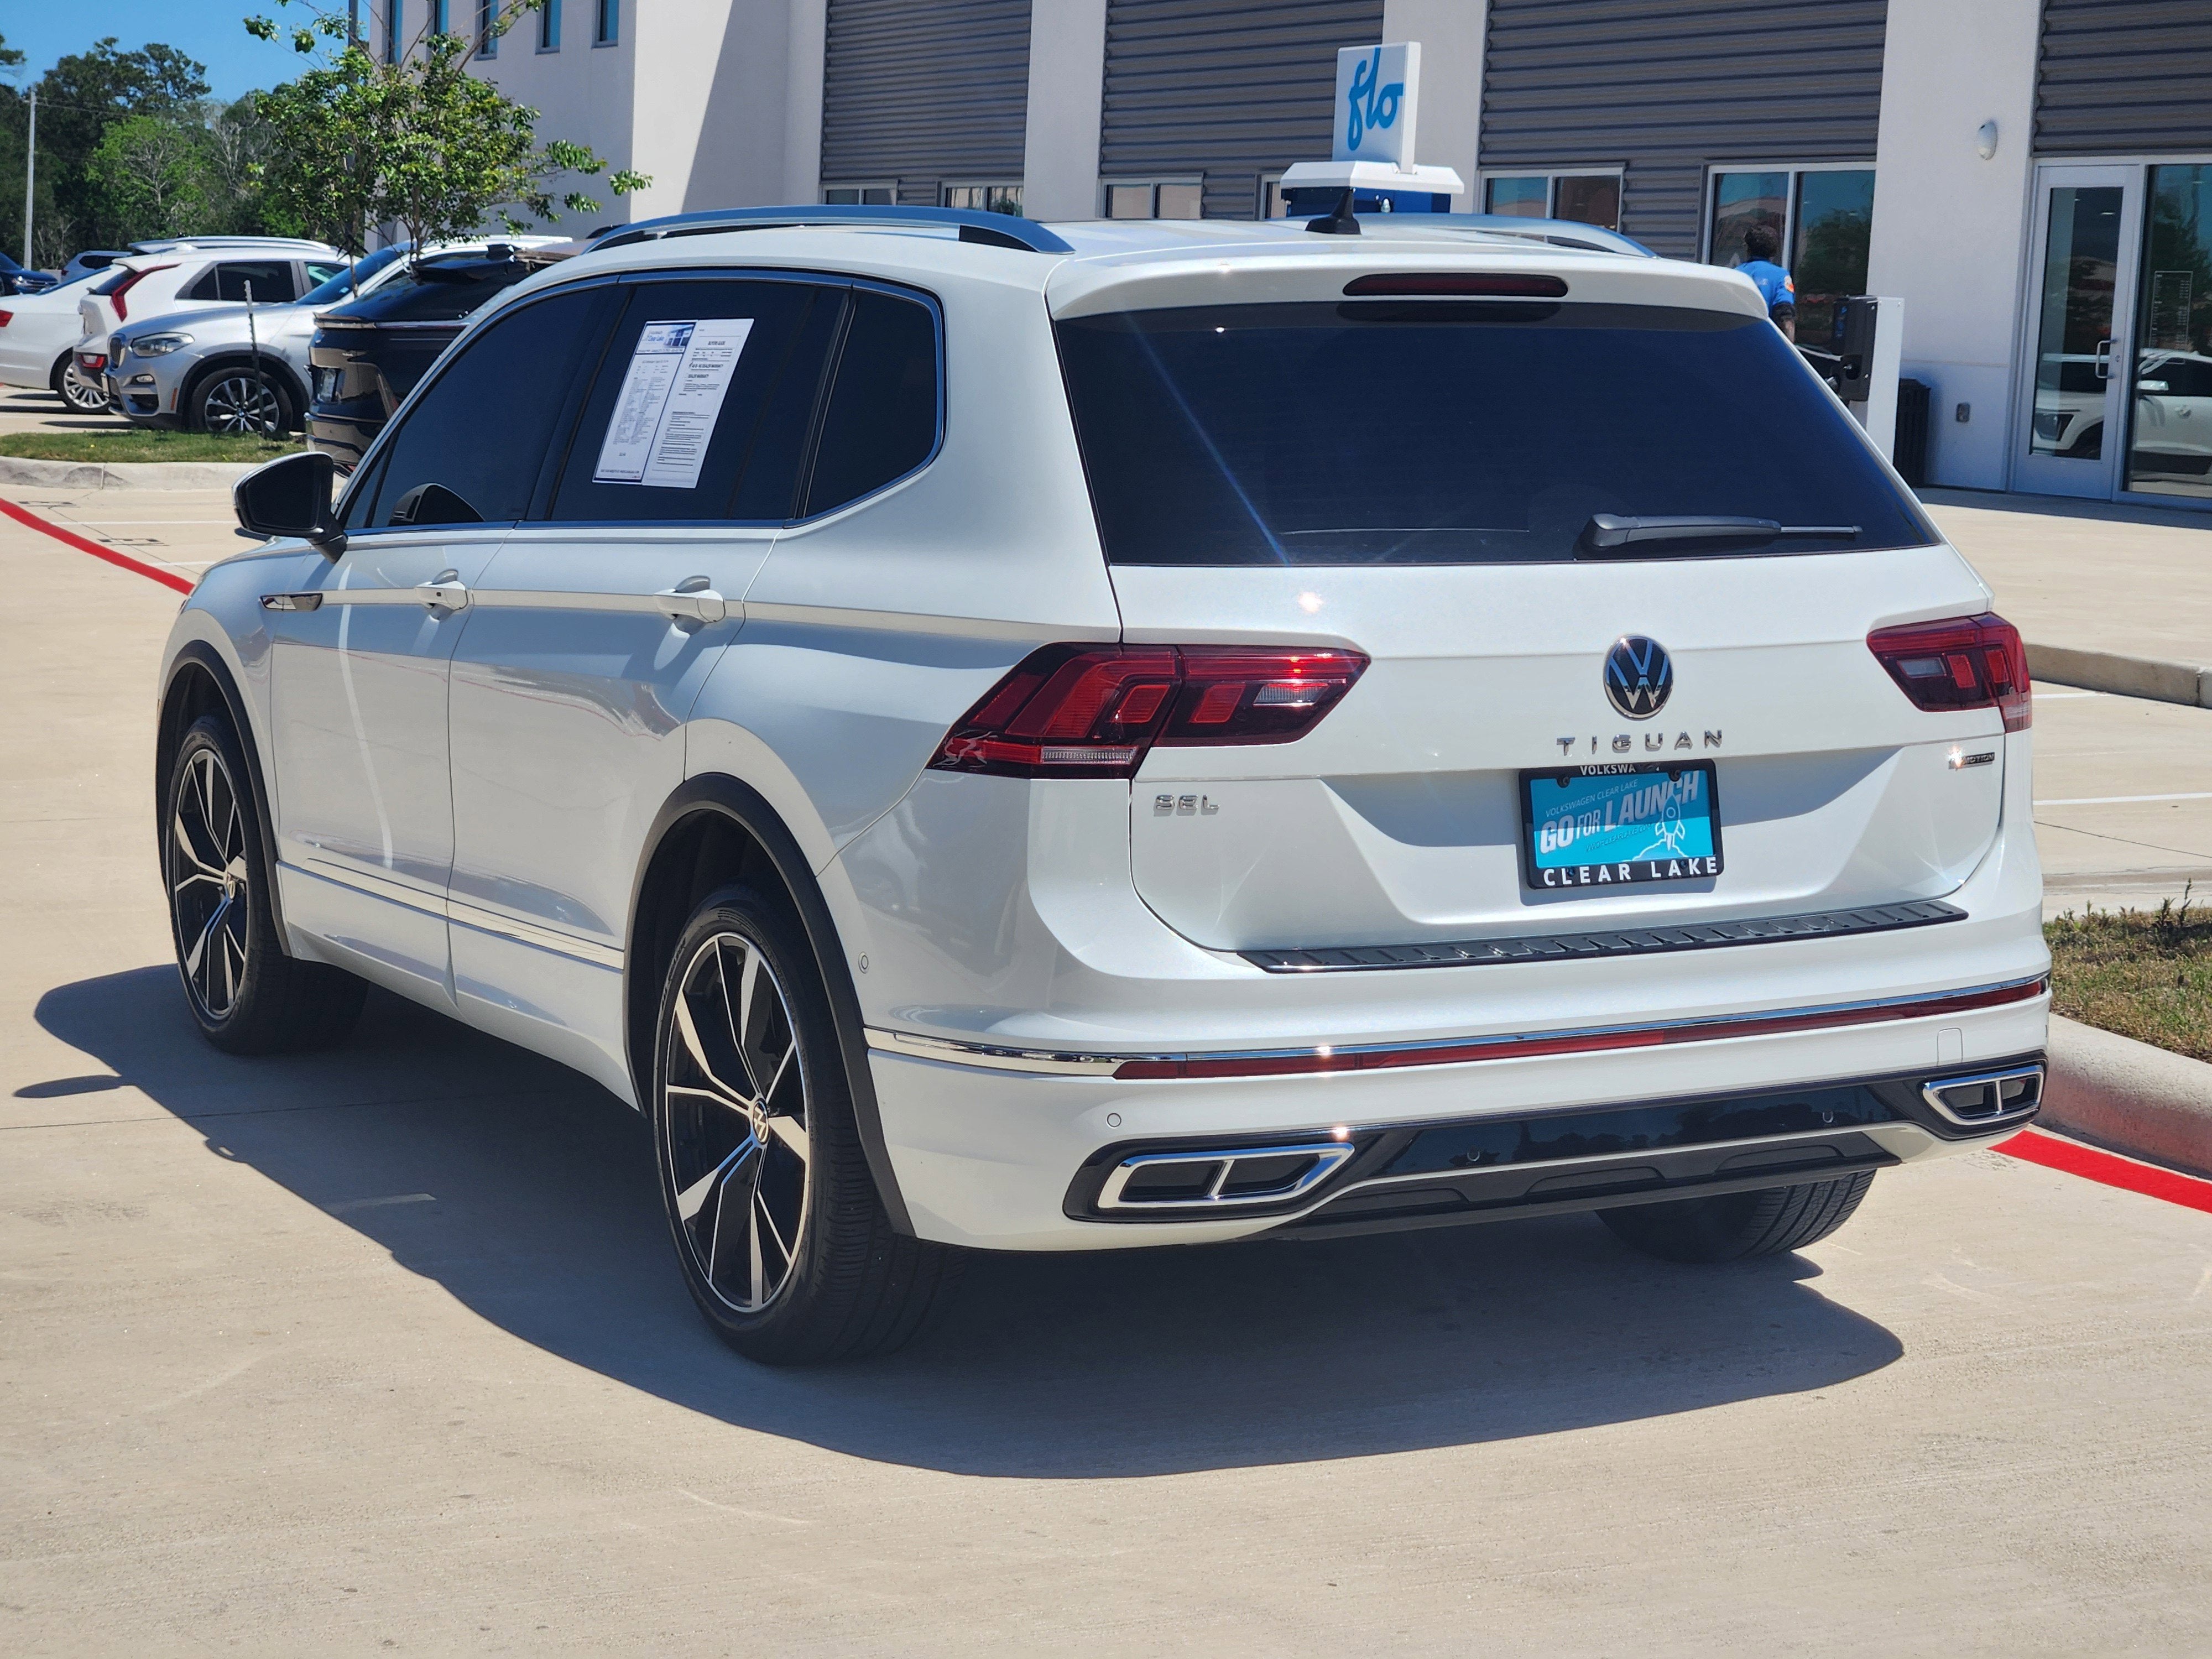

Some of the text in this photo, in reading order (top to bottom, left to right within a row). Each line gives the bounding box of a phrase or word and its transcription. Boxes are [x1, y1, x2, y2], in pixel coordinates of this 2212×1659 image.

[1348, 47, 1404, 151] flo
[1556, 730, 1723, 756] TIGUAN
[1155, 794, 1220, 810] SEL
[1540, 770, 1700, 854] GO FOR LAUNCH
[1546, 779, 1639, 817] VOLKSWAGEN CLEAR LAKE
[1584, 822, 1654, 853] VWOFCLEARLAKE.COM
[1543, 856, 1718, 886] CLEAR LAKE
